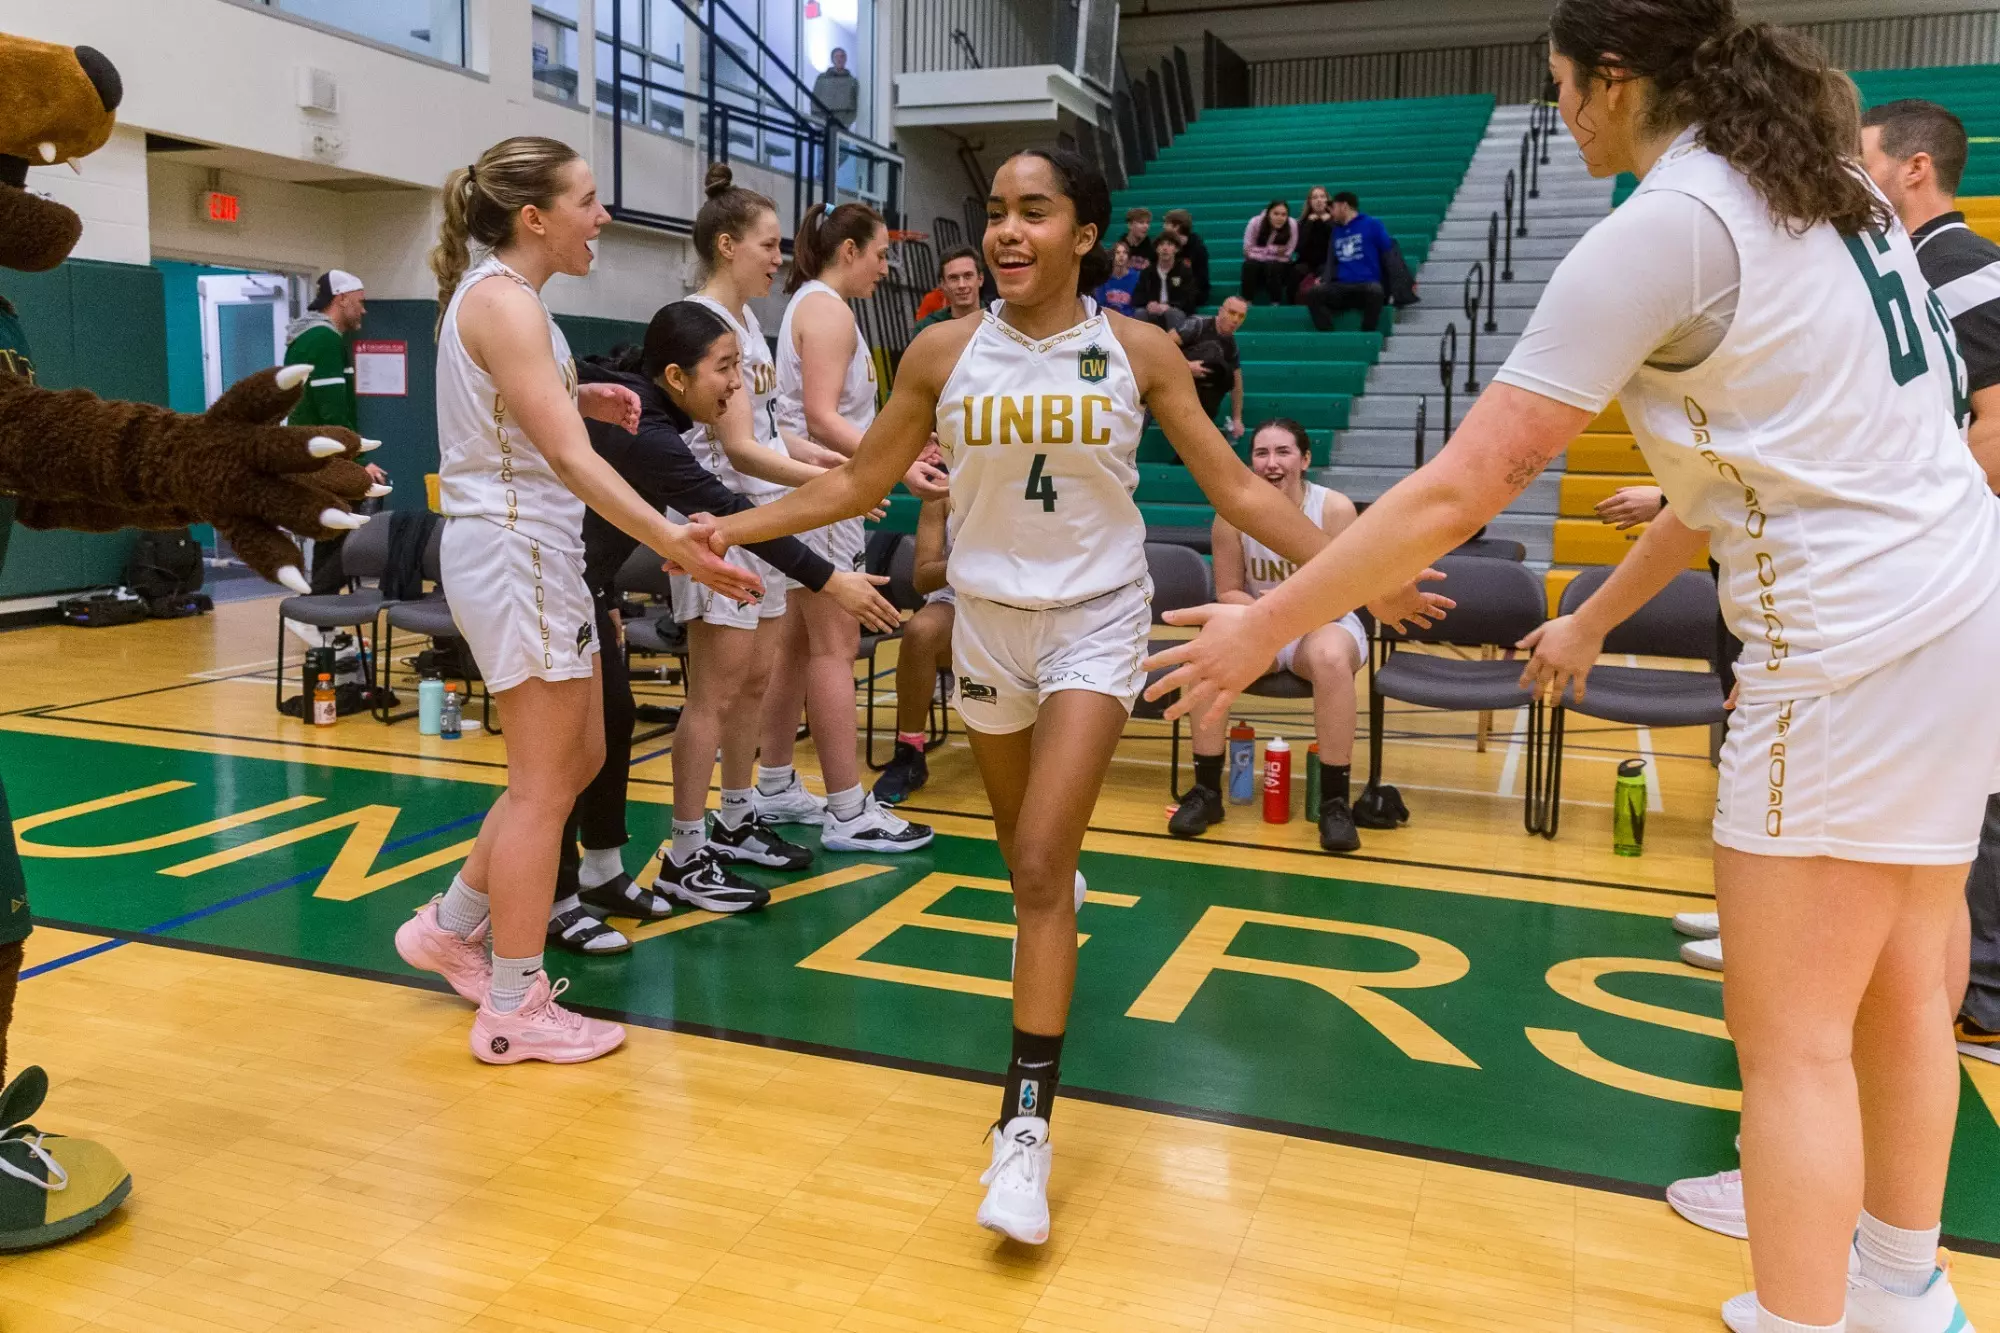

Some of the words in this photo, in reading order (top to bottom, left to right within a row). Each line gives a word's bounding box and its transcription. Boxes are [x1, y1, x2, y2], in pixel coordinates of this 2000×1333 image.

[209, 192, 239, 222] EXIT
[1080, 358, 1106, 378] CW
[963, 394, 1113, 447] UNBC
[1024, 453, 1058, 513] 4
